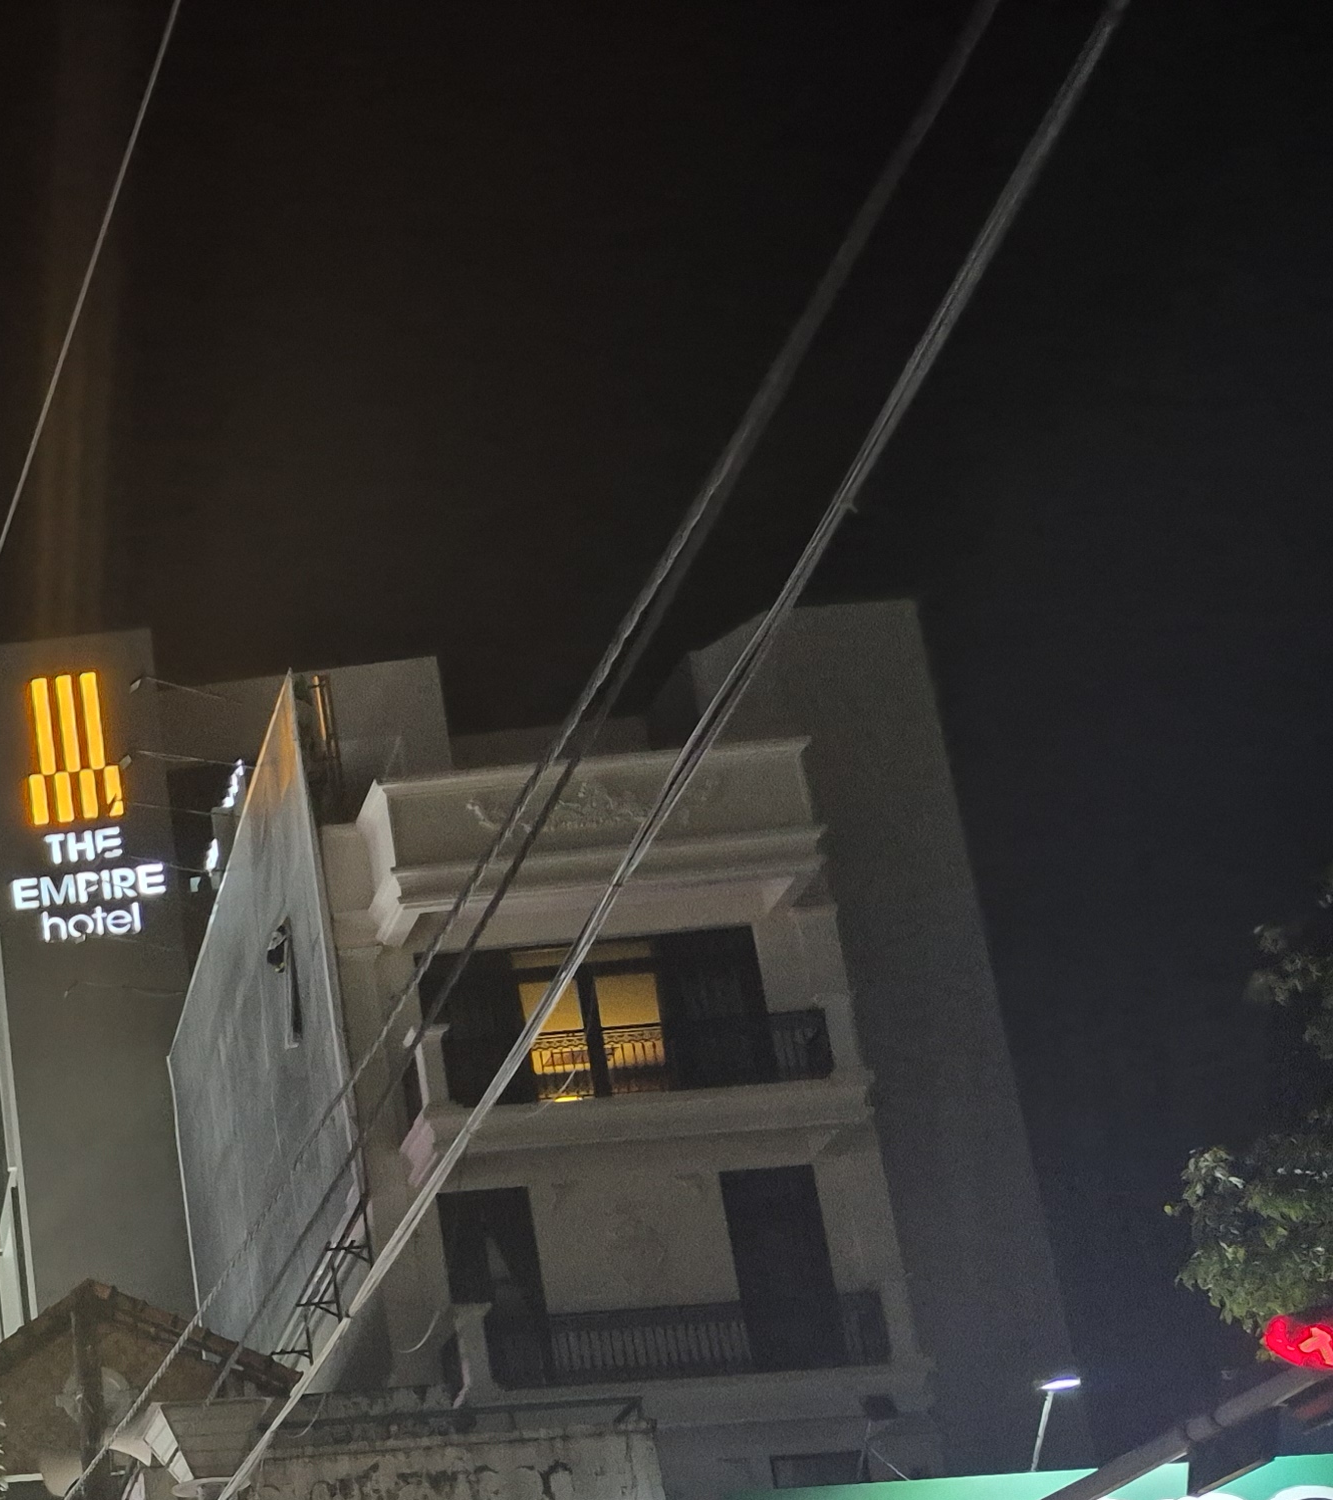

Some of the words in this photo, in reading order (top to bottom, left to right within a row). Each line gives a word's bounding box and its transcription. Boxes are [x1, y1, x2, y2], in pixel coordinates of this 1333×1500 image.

[44, 826, 123, 865] THE
[10, 863, 167, 911] EMPIRE
[41, 902, 142, 944] hotel
